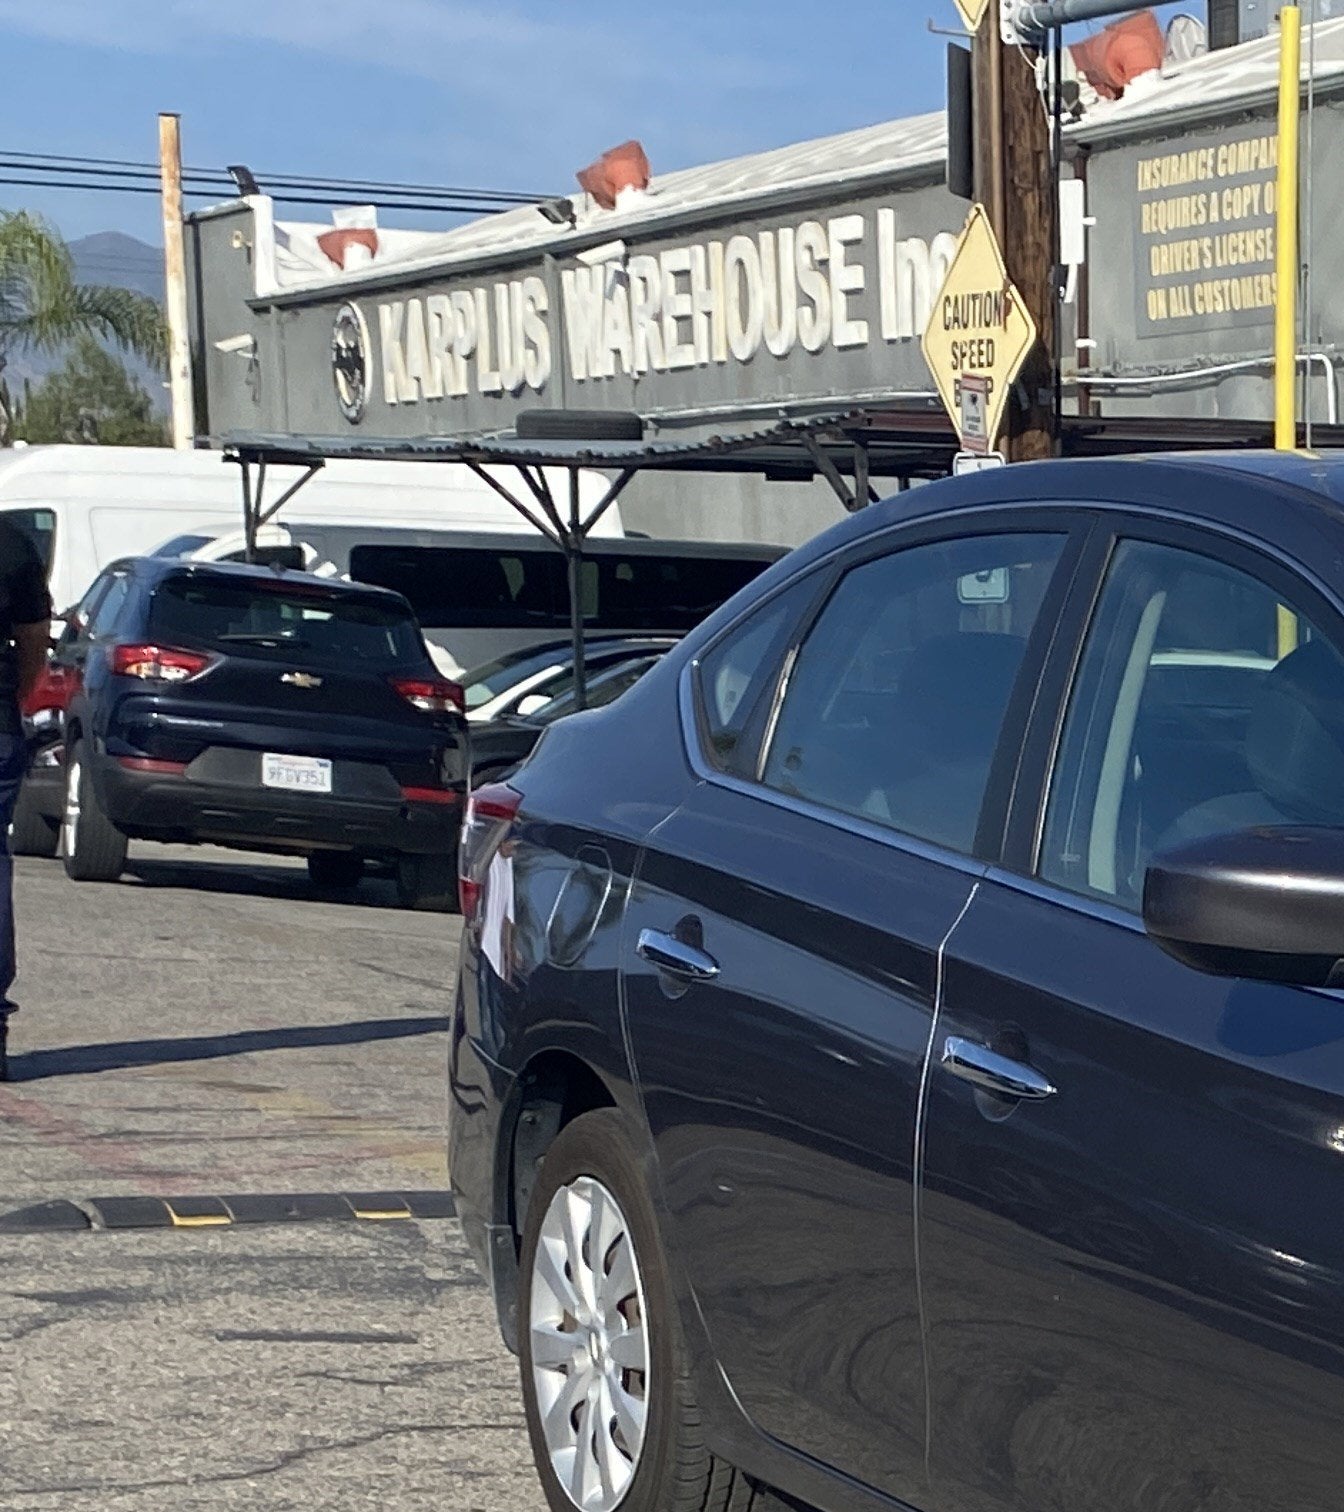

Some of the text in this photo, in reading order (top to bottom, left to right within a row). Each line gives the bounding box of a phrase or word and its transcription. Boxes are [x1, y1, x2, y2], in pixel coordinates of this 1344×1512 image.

[1137, 135, 1279, 192] INSURANCE COMPAN
[1141, 181, 1279, 235] REQUIRES A COPY O
[1150, 227, 1274, 277] DRIVER'S LICENSE
[378, 276, 551, 404] KARPLUS
[561, 213, 869, 381] WAREHOUSE
[942, 291, 1003, 331] CAUTION
[1147, 272, 1278, 321] ON ALL CUSTOMERS
[951, 338, 995, 371] SPEED
[954, 376, 994, 408] BP
